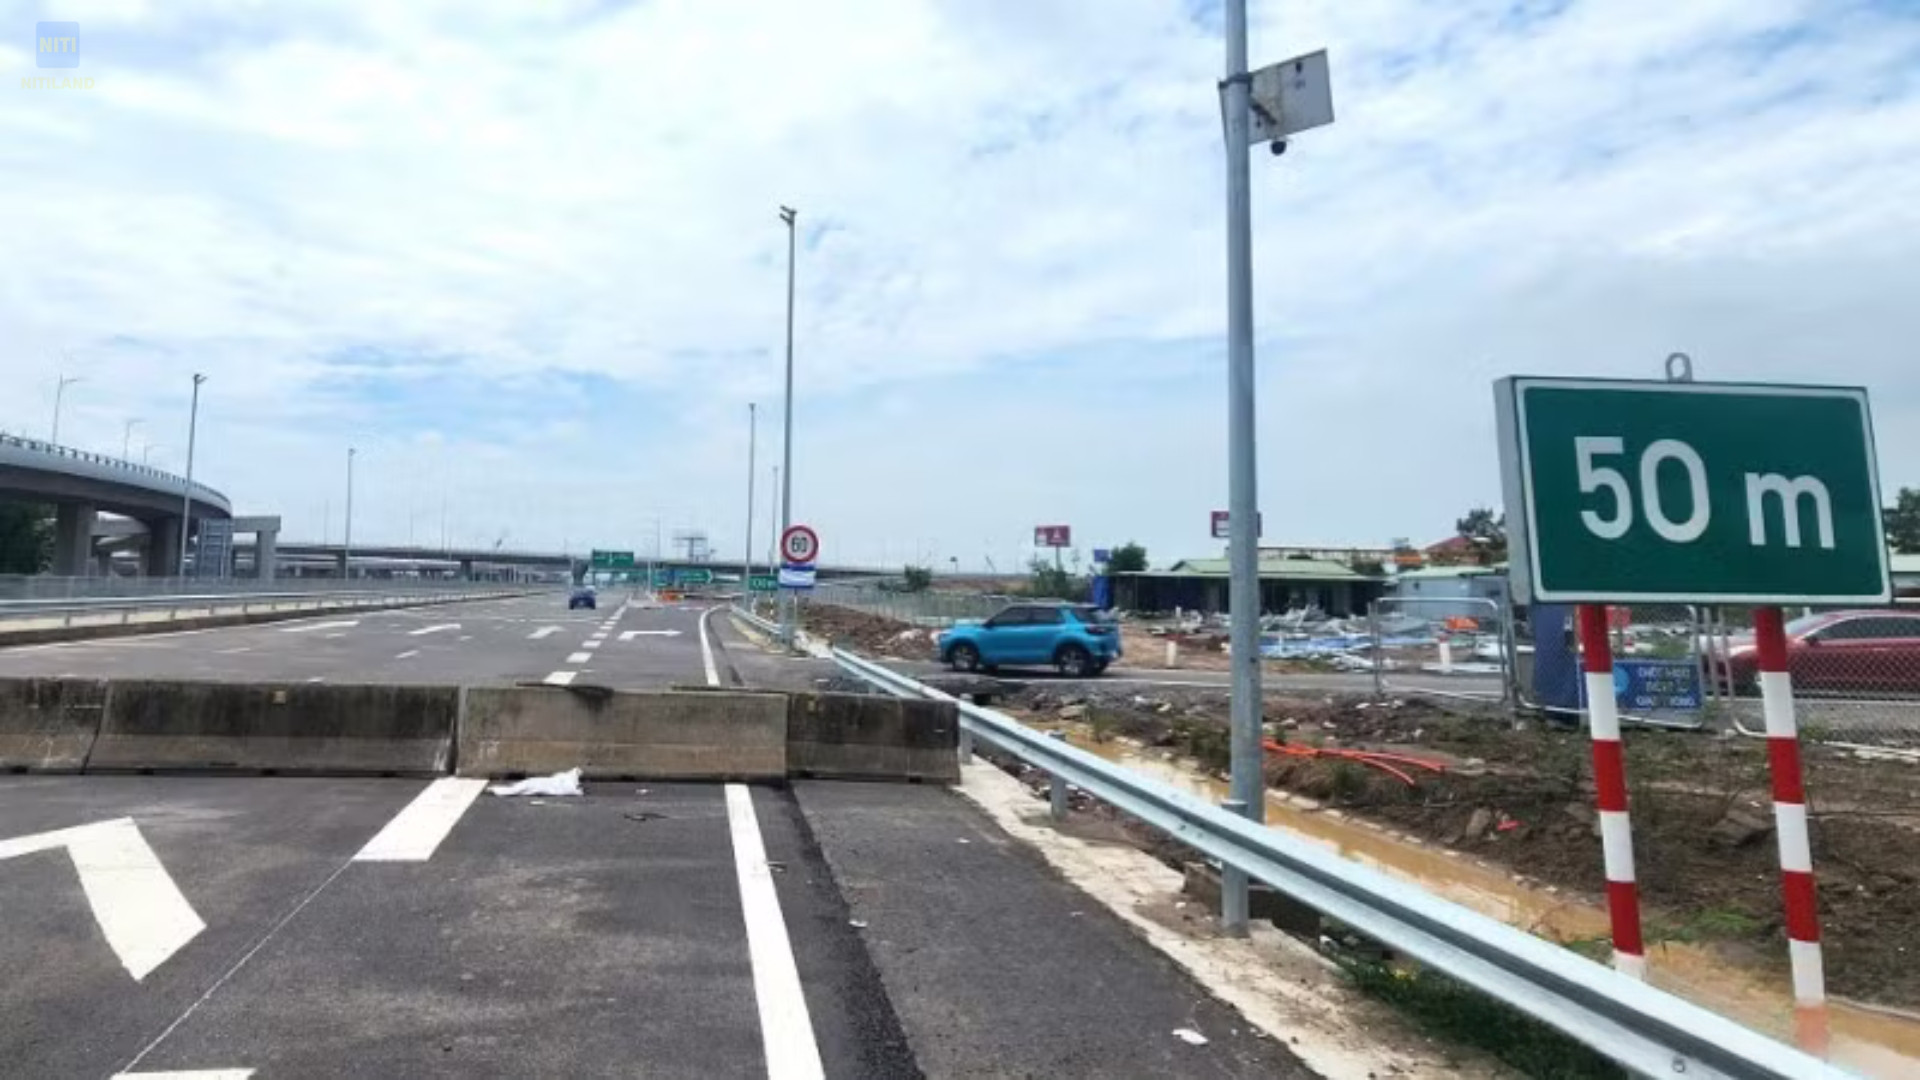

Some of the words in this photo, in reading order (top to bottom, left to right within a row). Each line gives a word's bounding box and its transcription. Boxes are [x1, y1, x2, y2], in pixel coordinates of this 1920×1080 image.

[1574, 436, 1710, 543] 50
[1744, 472, 1835, 549] m
[791, 536, 808, 553] 60
